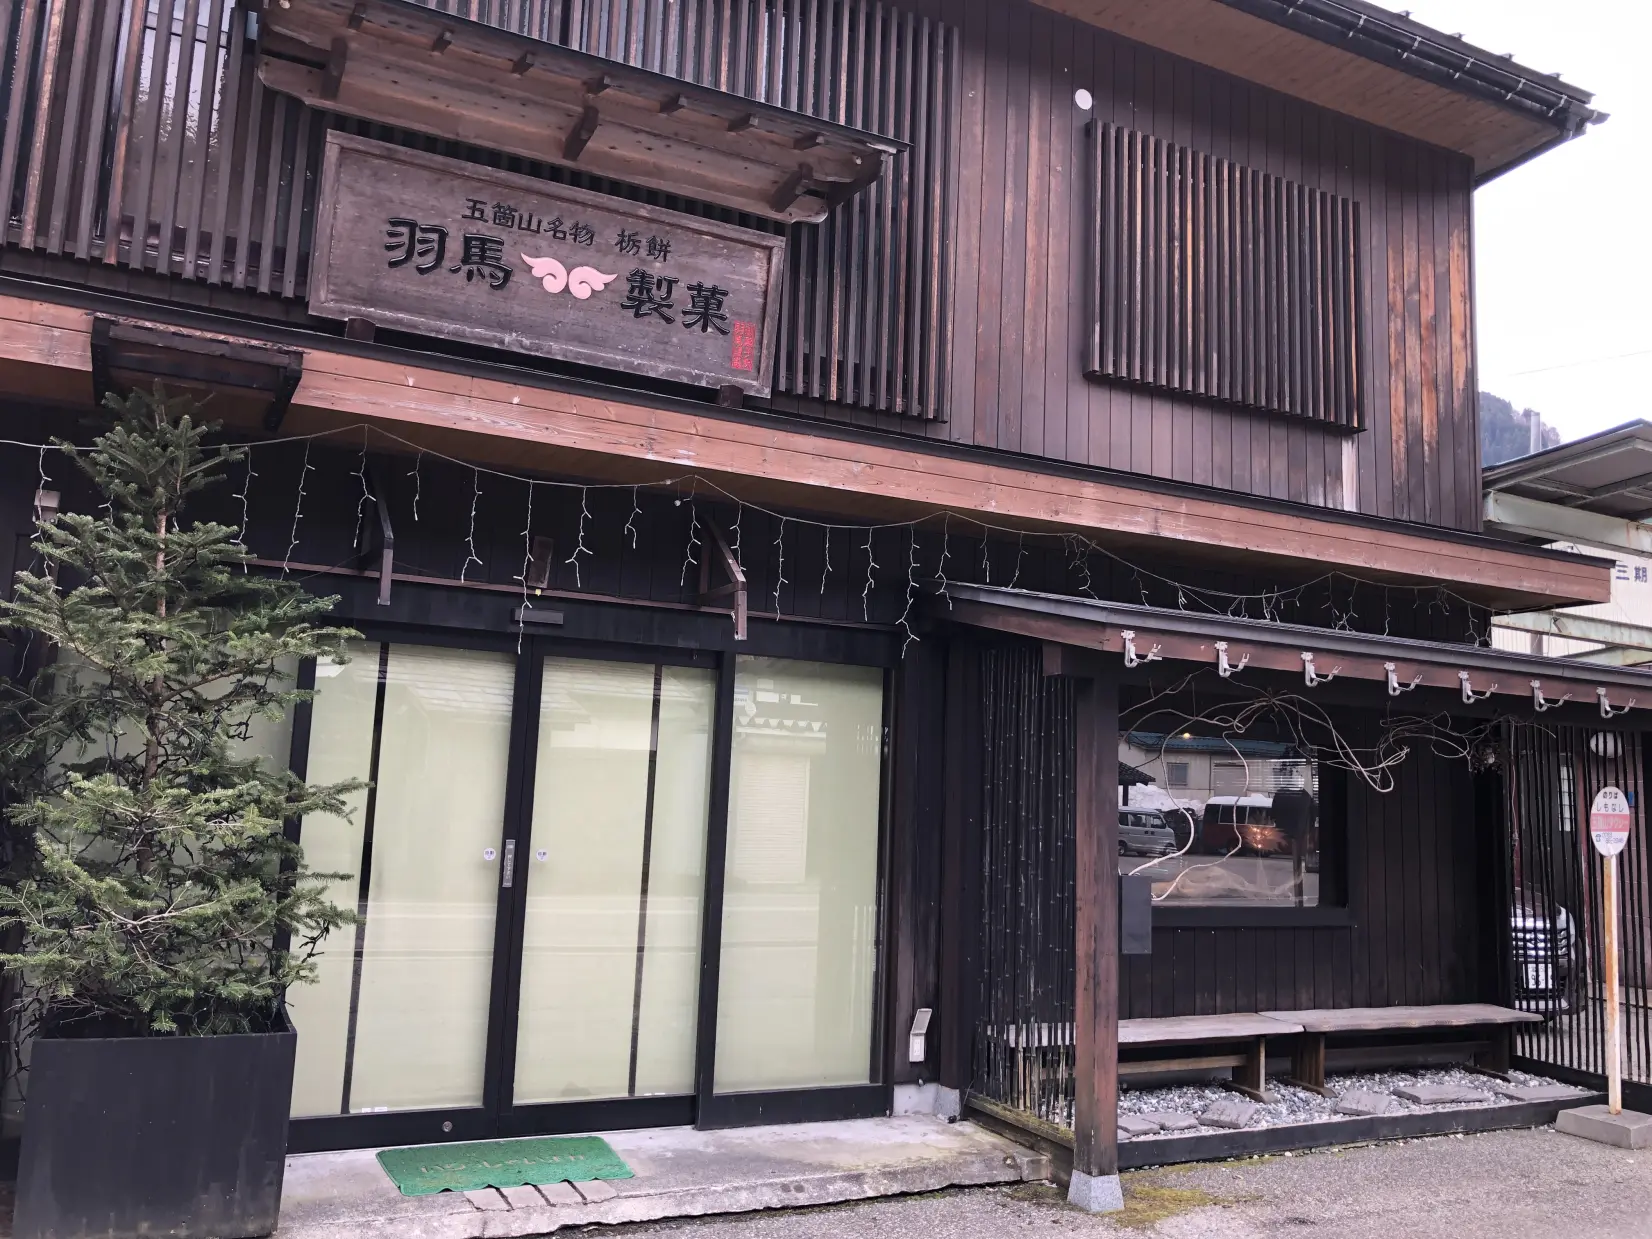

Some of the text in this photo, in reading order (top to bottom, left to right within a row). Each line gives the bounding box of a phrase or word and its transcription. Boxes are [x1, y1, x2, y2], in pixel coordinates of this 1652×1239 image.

[461, 198, 672, 262] 五箇山名物 栃餅
[384, 217, 731, 335] 羽馬 製菓
[1596, 802, 1624, 812] しもなし
